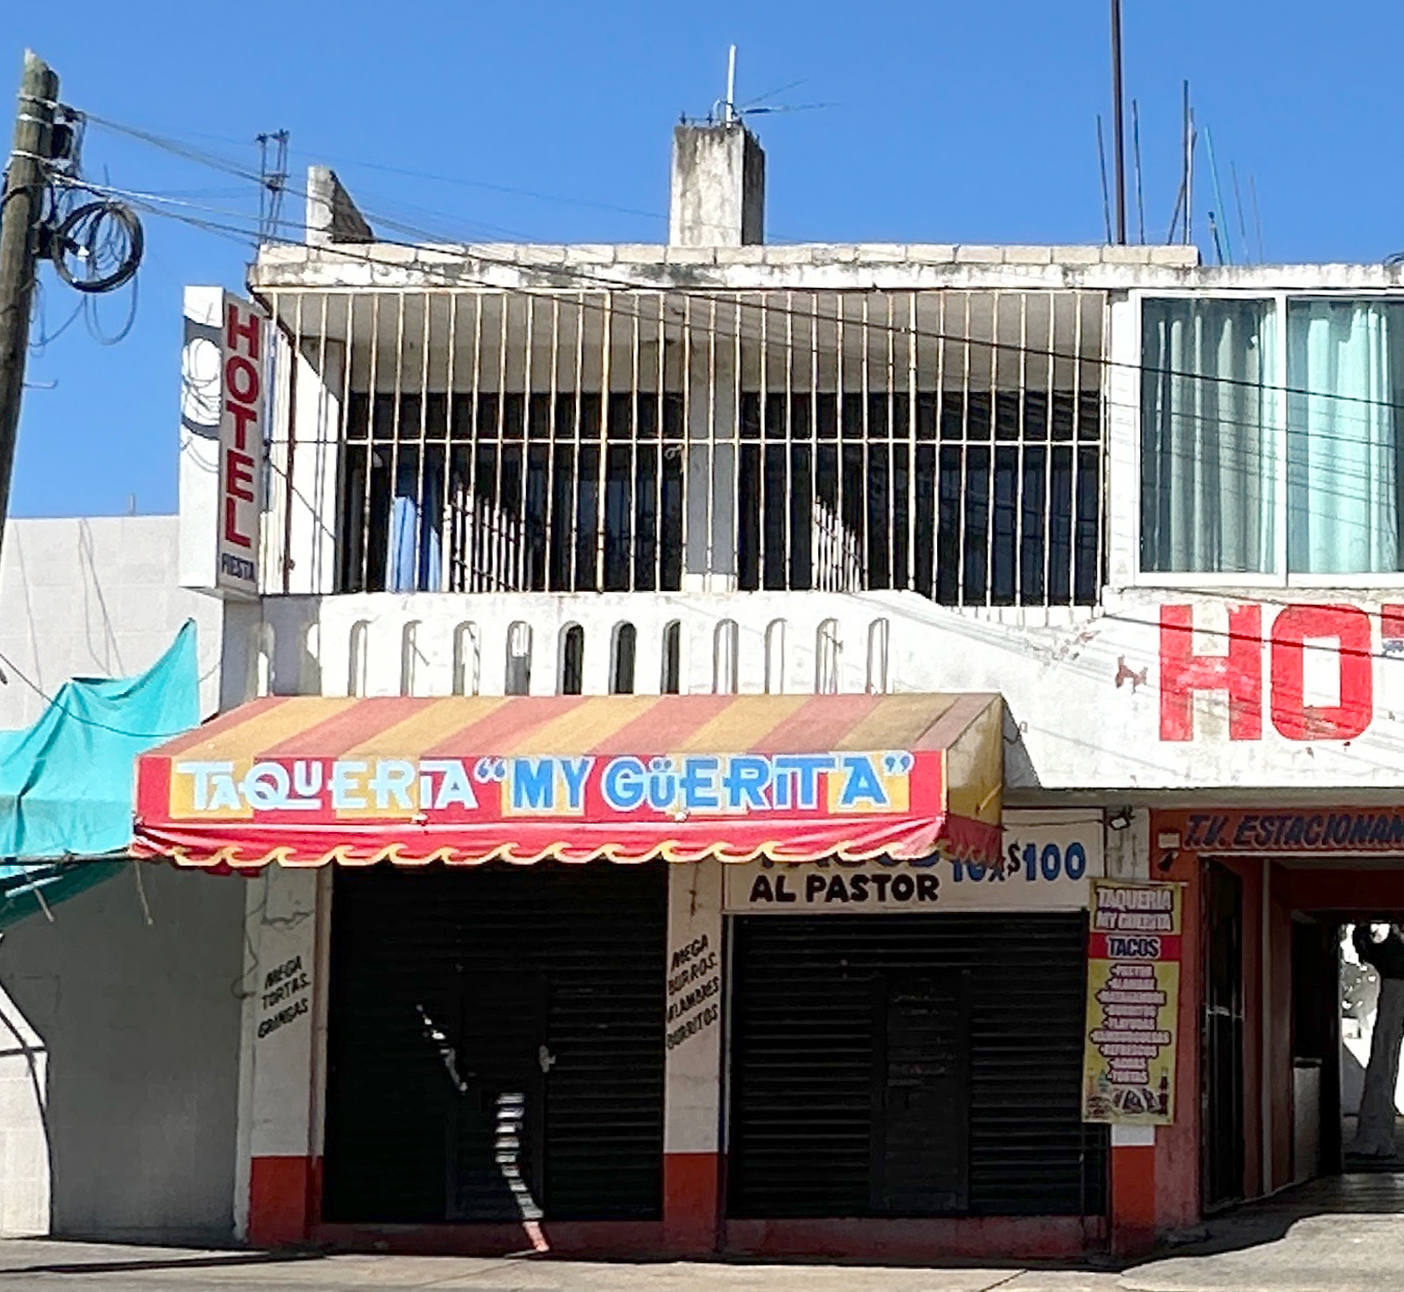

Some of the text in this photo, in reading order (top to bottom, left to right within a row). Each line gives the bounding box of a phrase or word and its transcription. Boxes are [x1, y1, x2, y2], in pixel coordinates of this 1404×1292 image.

[225, 303, 259, 549] HOTEL
[1183, 814, 1230, 846] T.V.
[750, 873, 940, 903] AL PASTOR
[1096, 888, 1172, 911] TAQUERIA
[1108, 937, 1160, 958] TACOS
